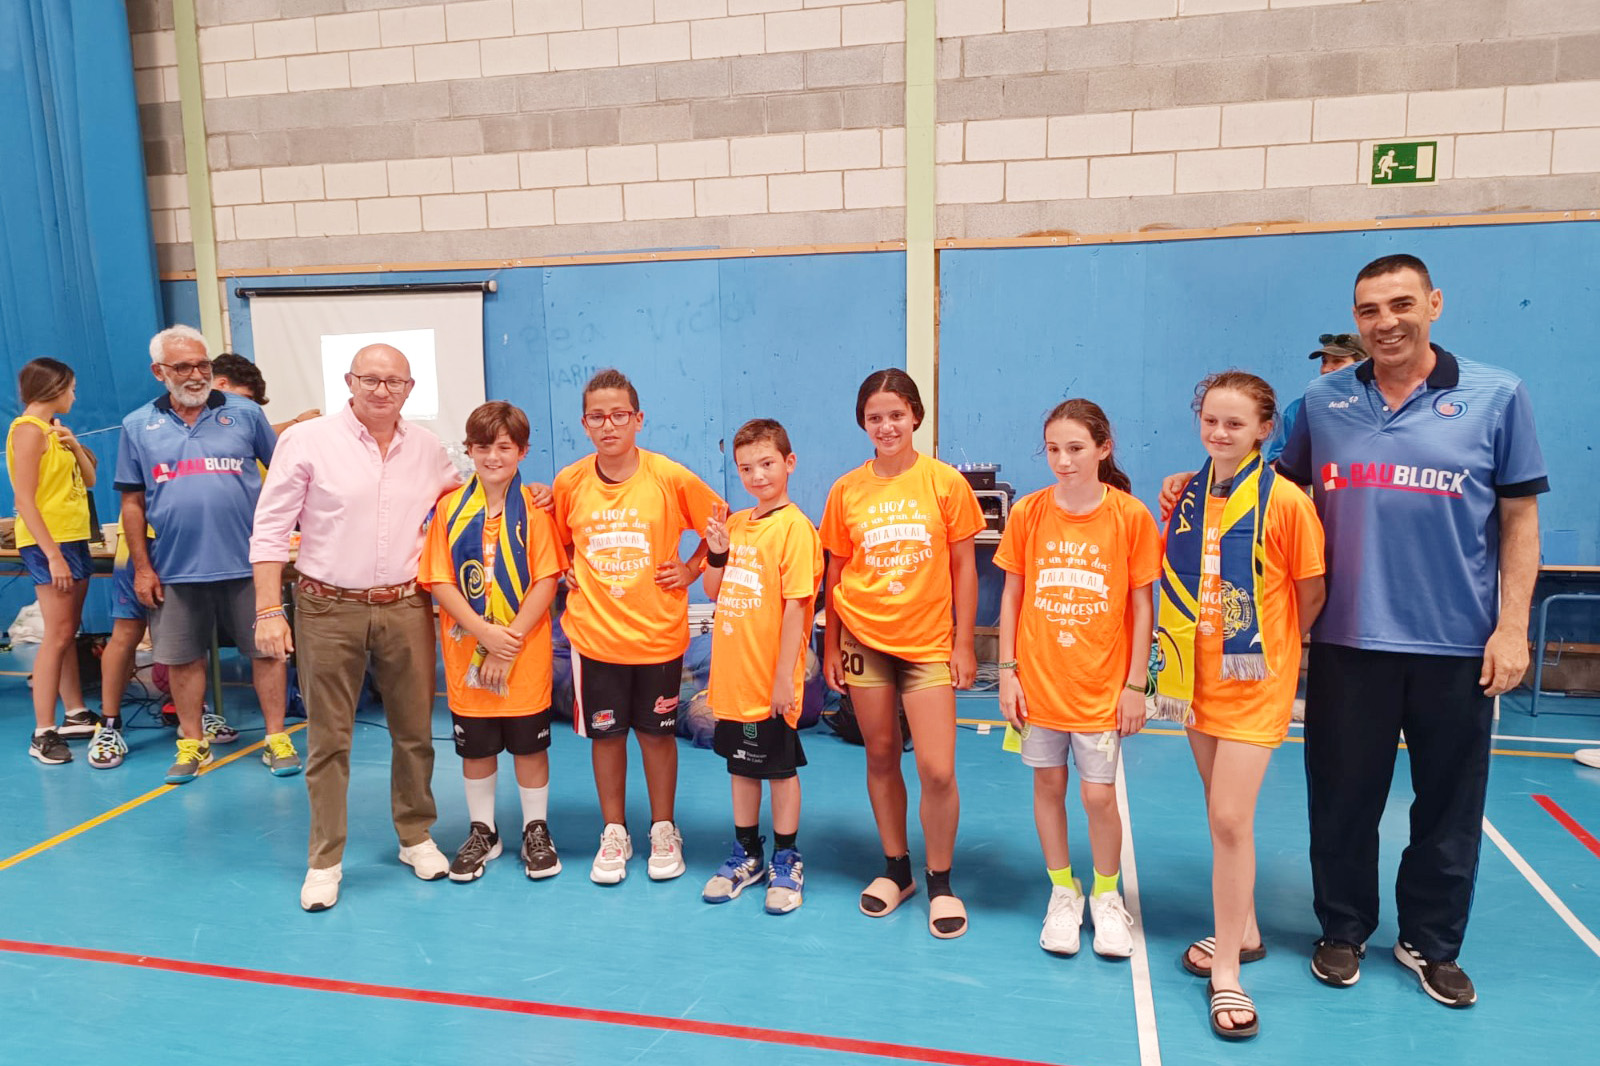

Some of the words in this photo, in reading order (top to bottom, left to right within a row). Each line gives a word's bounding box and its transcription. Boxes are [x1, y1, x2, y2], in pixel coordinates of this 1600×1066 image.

[1351, 462, 1468, 494] BAUBLOCK
[602, 508, 627, 521] HOY
[879, 499, 905, 514] HOY
[890, 540, 900, 553] al
[1059, 541, 1087, 556] HOY
[865, 548, 933, 568] BALONCESTO
[1063, 588, 1074, 600] al
[1034, 596, 1109, 615] BALONCESTO
[841, 650, 864, 675] 20
[1097, 731, 1115, 762] 4
